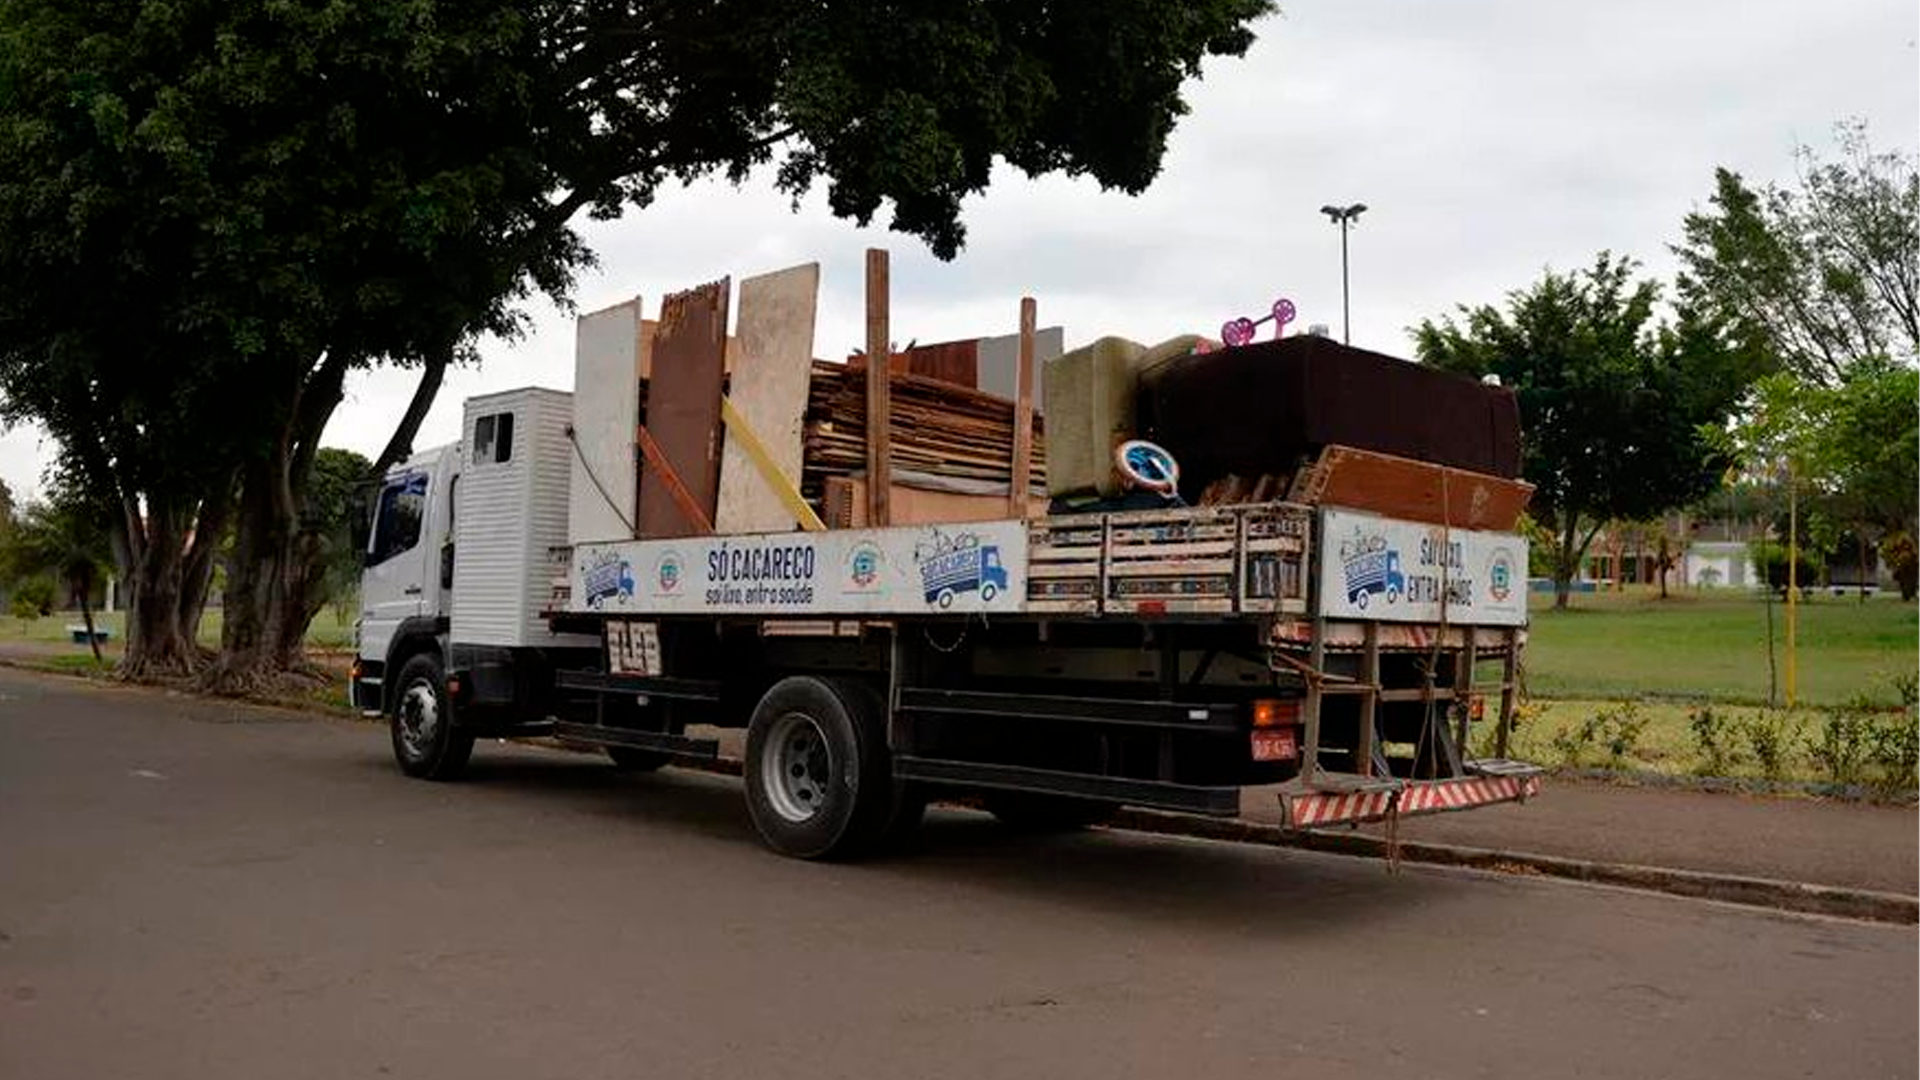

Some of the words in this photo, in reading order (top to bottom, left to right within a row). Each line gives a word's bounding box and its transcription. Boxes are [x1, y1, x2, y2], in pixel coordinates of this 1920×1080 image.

[708, 541, 728, 581] SÓ
[732, 546, 814, 581] CACARECO
[1421, 538, 1437, 566] SAI
[1439, 541, 1465, 573] LXO,
[1407, 575, 1439, 602] ENTRA
